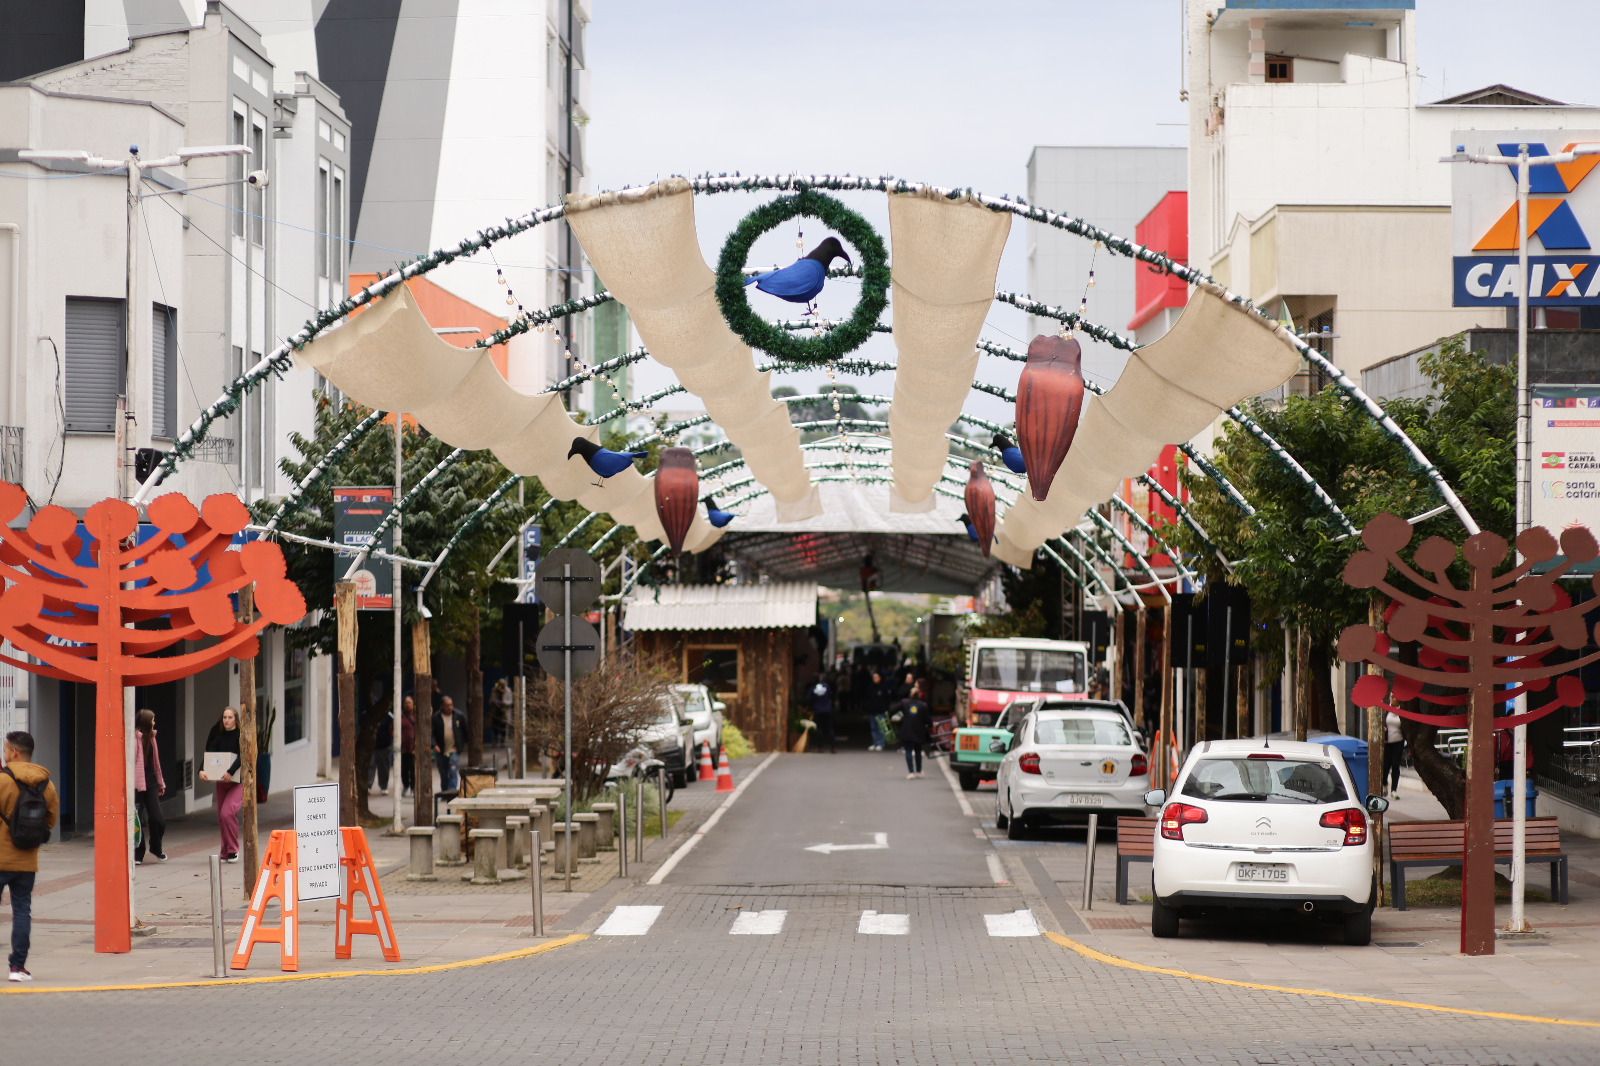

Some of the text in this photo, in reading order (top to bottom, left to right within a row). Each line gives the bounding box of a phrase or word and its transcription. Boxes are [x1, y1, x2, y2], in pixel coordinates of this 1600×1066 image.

[1566, 481, 1595, 489] santa
[308, 796, 326, 804] ACESSO
[307, 813, 327, 821] SOMENTE
[311, 829, 337, 837] MORADORES
[298, 863, 337, 873] ESTACIONAMENTO
